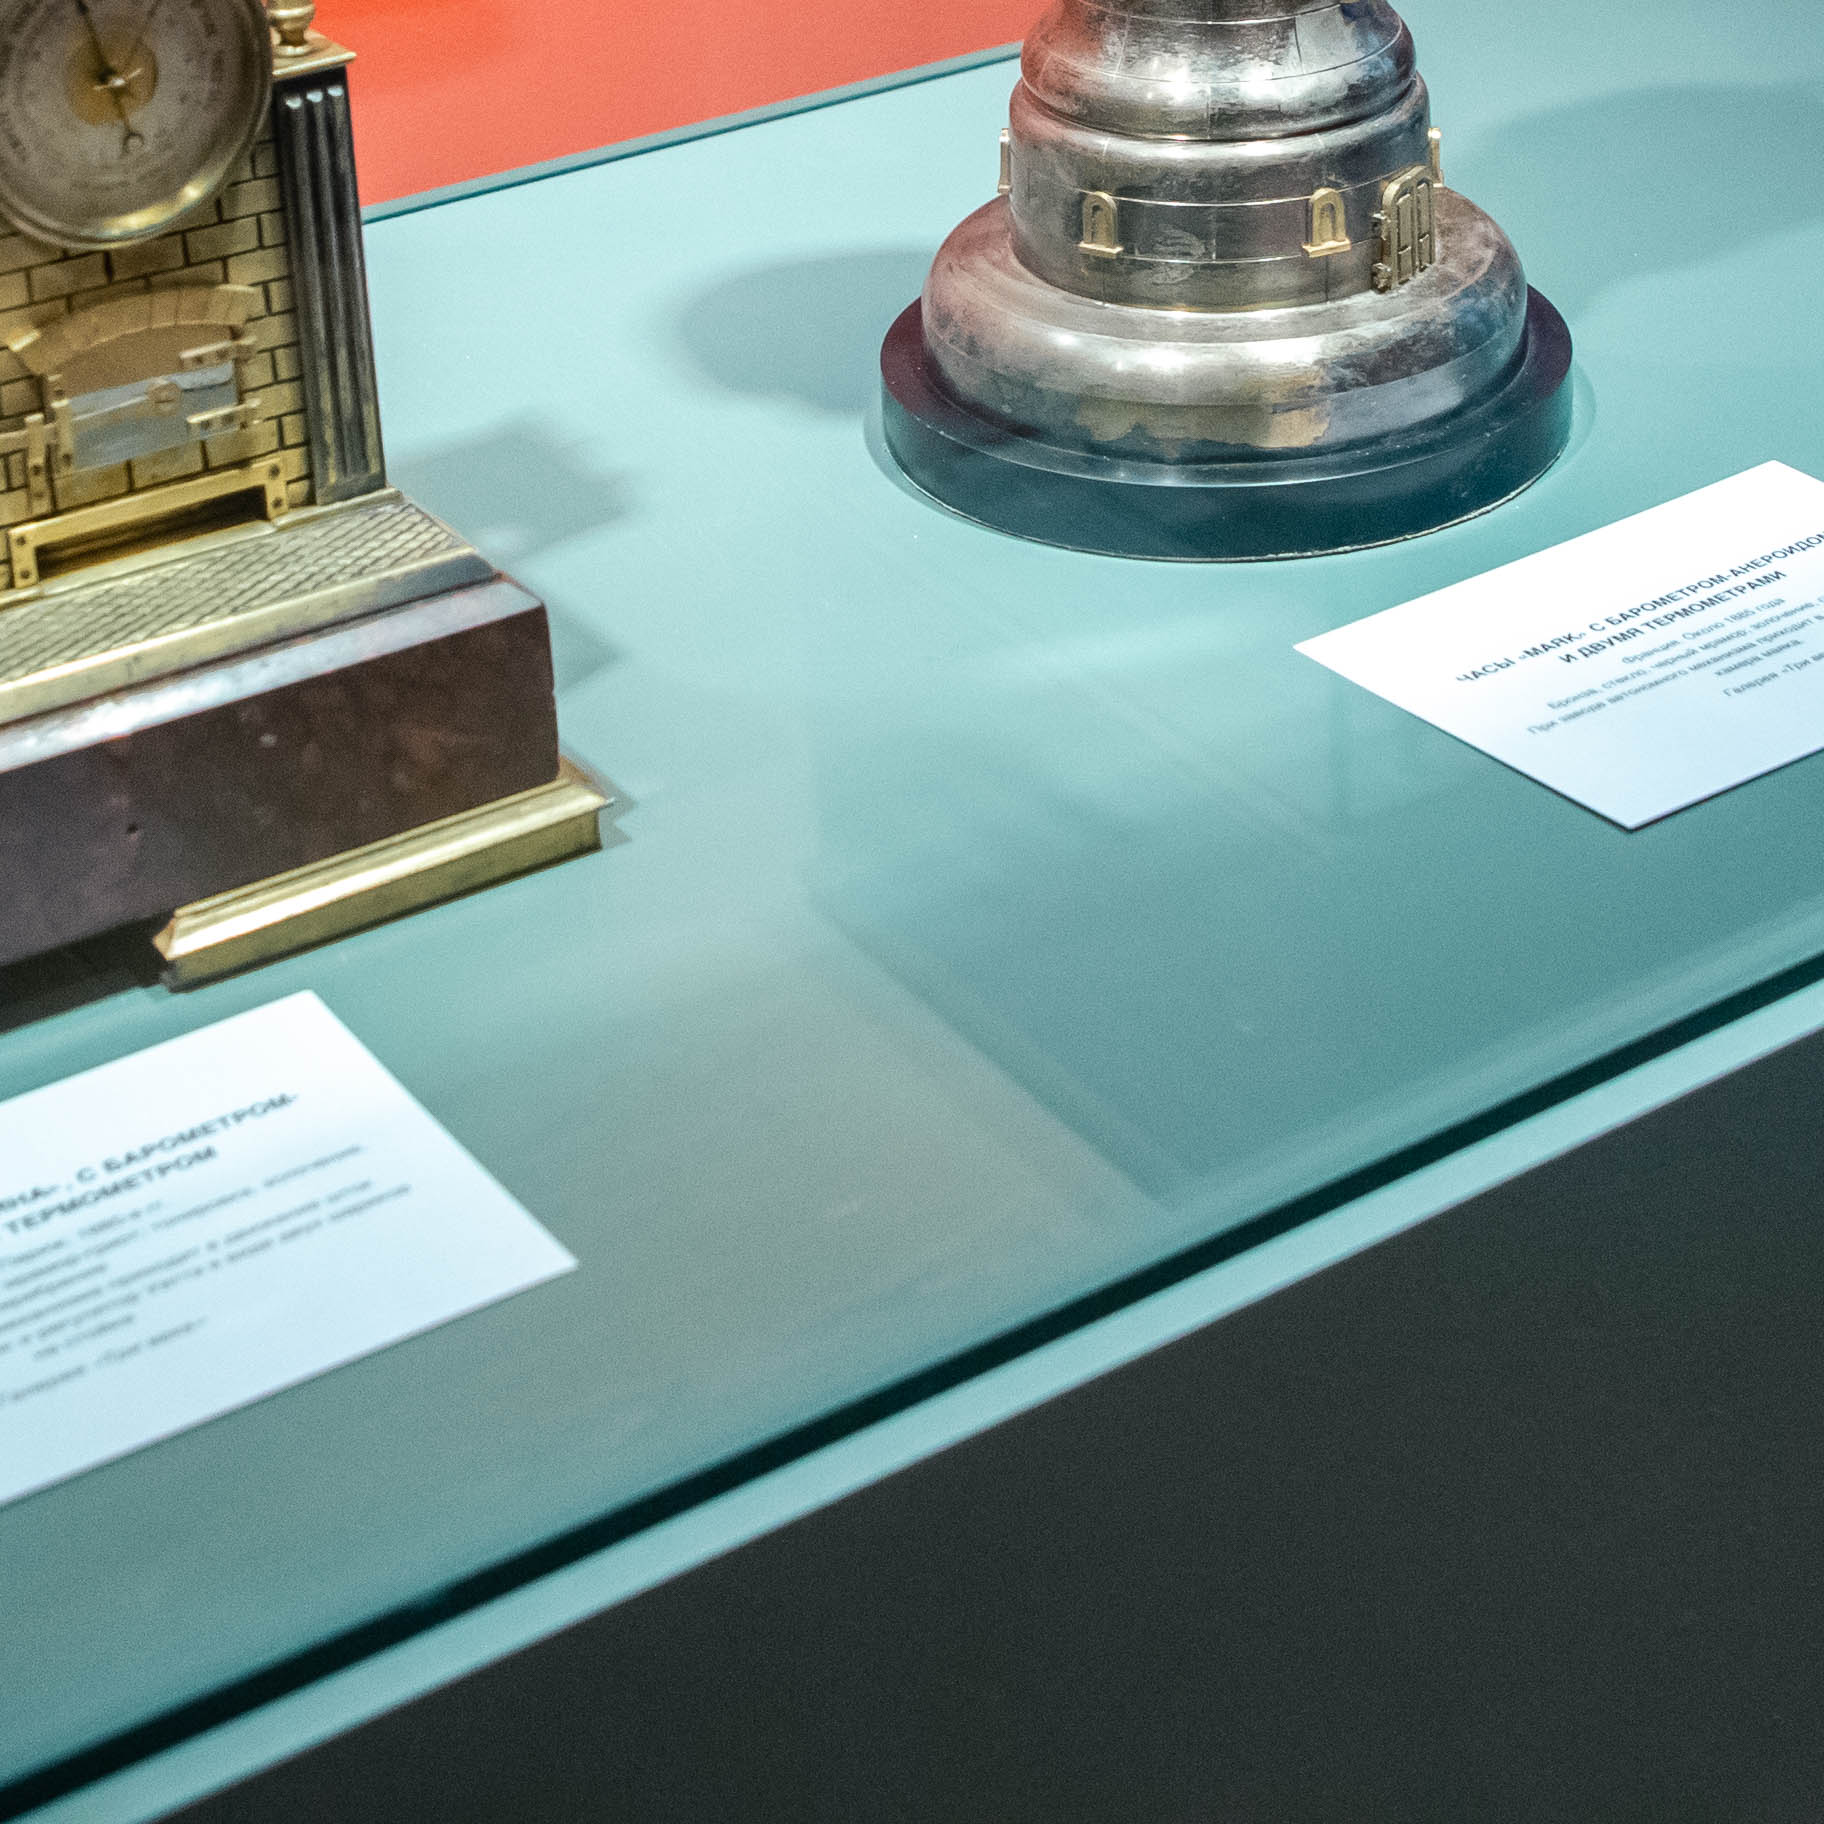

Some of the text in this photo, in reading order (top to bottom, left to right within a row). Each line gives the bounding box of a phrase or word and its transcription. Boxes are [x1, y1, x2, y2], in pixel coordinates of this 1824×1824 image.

[1456, 657, 1515, 681] ЧАСЫ
[1519, 632, 1585, 659] «МАЯК»
[1577, 627, 1644, 657] ДВУМЯ
[1642, 571, 1785, 629] ТЕРМОМЕТРАМИ
[6, 1147, 216, 1232] ТЕРМОМЕТРОМ
